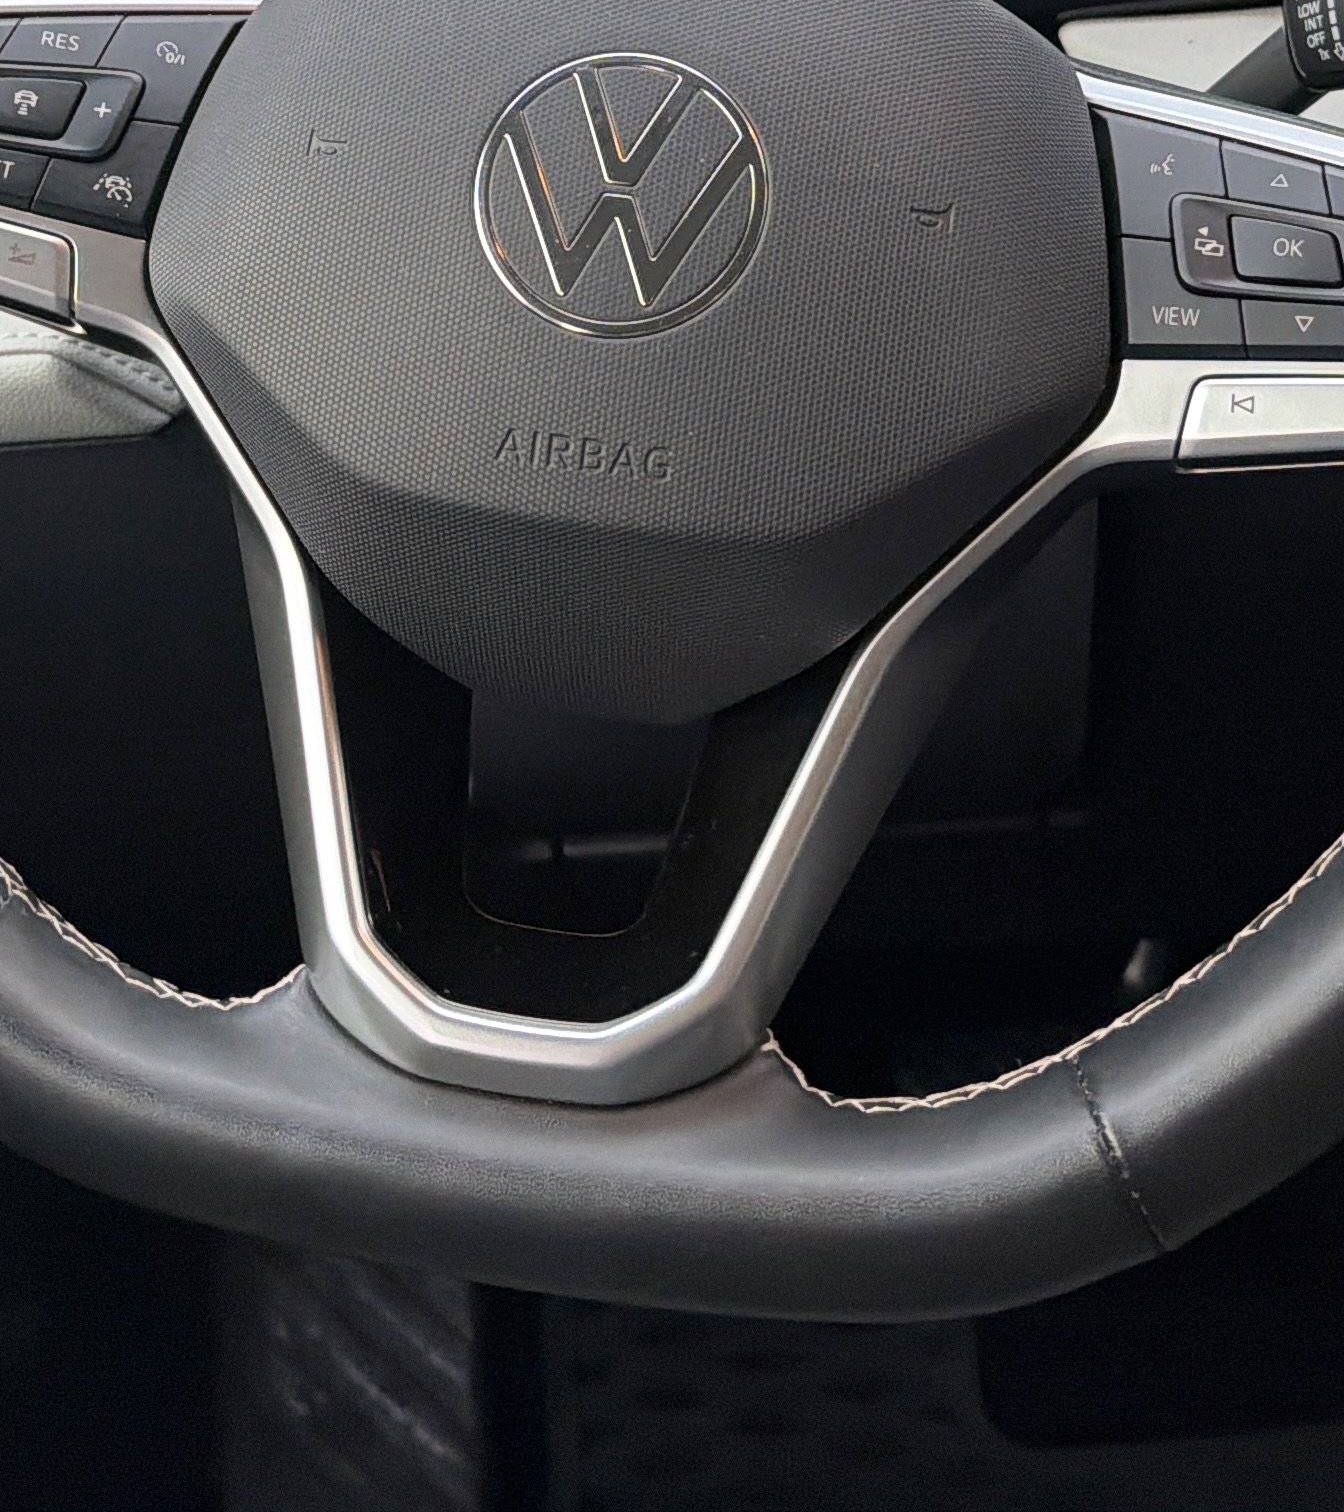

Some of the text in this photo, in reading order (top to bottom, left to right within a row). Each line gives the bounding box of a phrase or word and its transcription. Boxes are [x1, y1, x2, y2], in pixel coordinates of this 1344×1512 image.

[1297, 1, 1321, 19] LOW
[1304, 15, 1324, 31] INT
[40, 30, 81, 52] RES
[1306, 34, 1326, 49] OFF
[1272, 237, 1305, 258] OK
[1152, 305, 1201, 327] VIEW
[494, 426, 673, 483] AIRBAG
